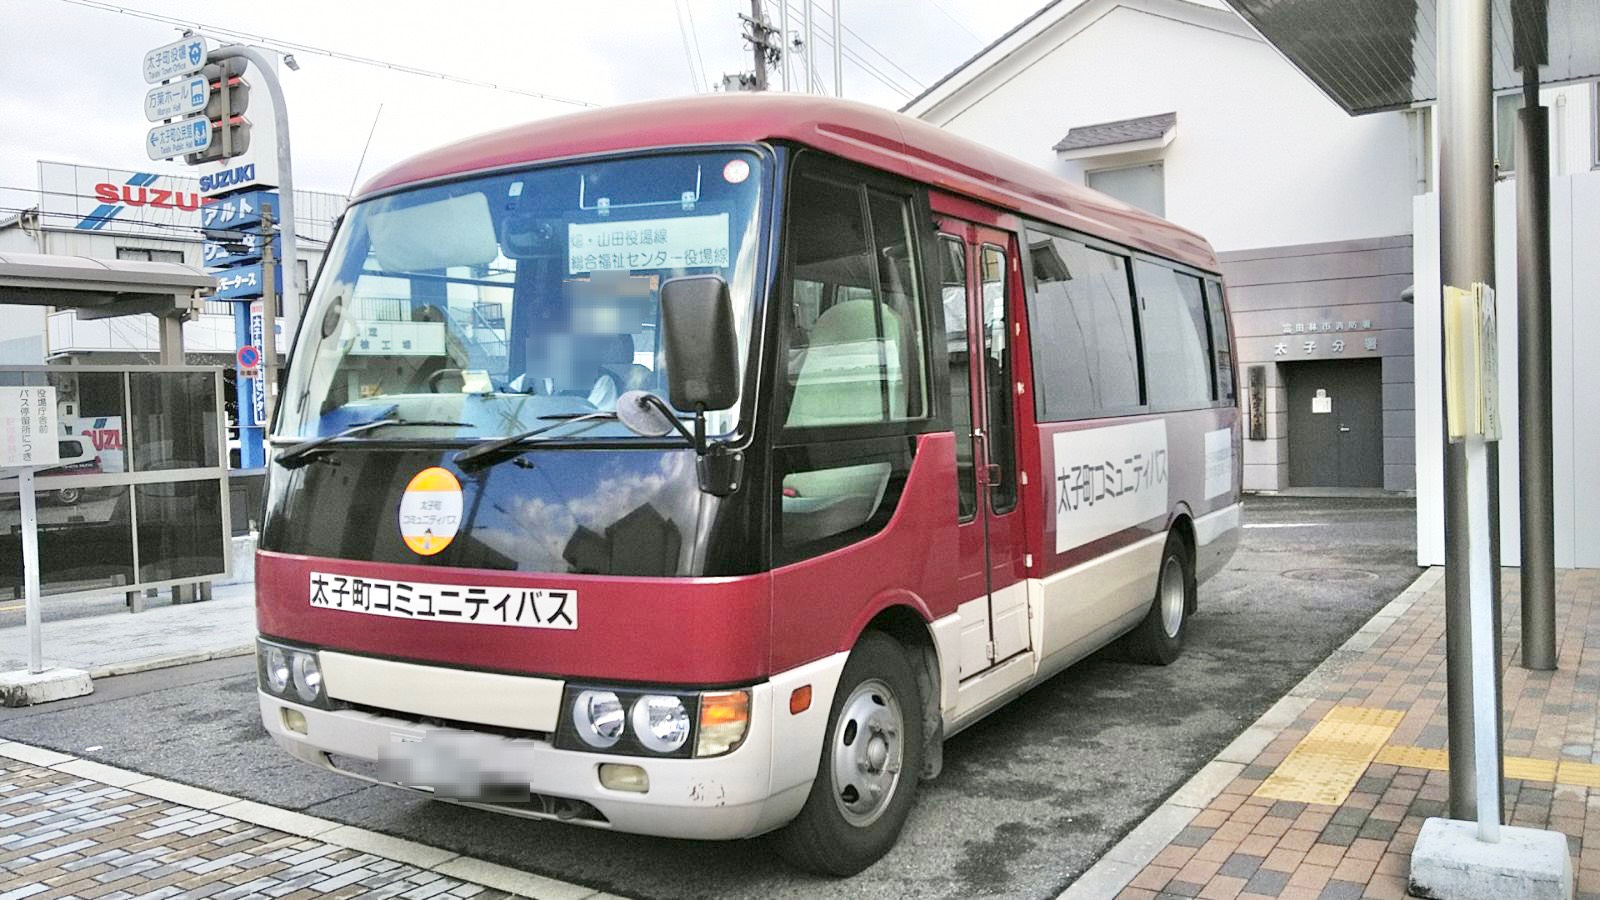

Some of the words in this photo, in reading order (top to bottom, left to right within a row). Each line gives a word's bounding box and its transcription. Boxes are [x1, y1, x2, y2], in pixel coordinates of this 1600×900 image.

[147, 44, 186, 70] 太子町役場
[149, 85, 189, 109] 万葉ホール
[199, 163, 256, 193] SUZUKI
[95, 183, 217, 213] SUZU
[203, 197, 254, 226] アルト
[571, 247, 728, 271] 総合福祉センター役場線
[1274, 337, 1377, 356] 太子分署
[20, 389, 32, 462] バス停留所につき
[1057, 449, 1168, 514] 太子町コミュニティバス
[420, 500, 443, 511] 太子町
[403, 515, 457, 525] コミュニティバス
[311, 574, 573, 626] 太子町コミュニティバス
